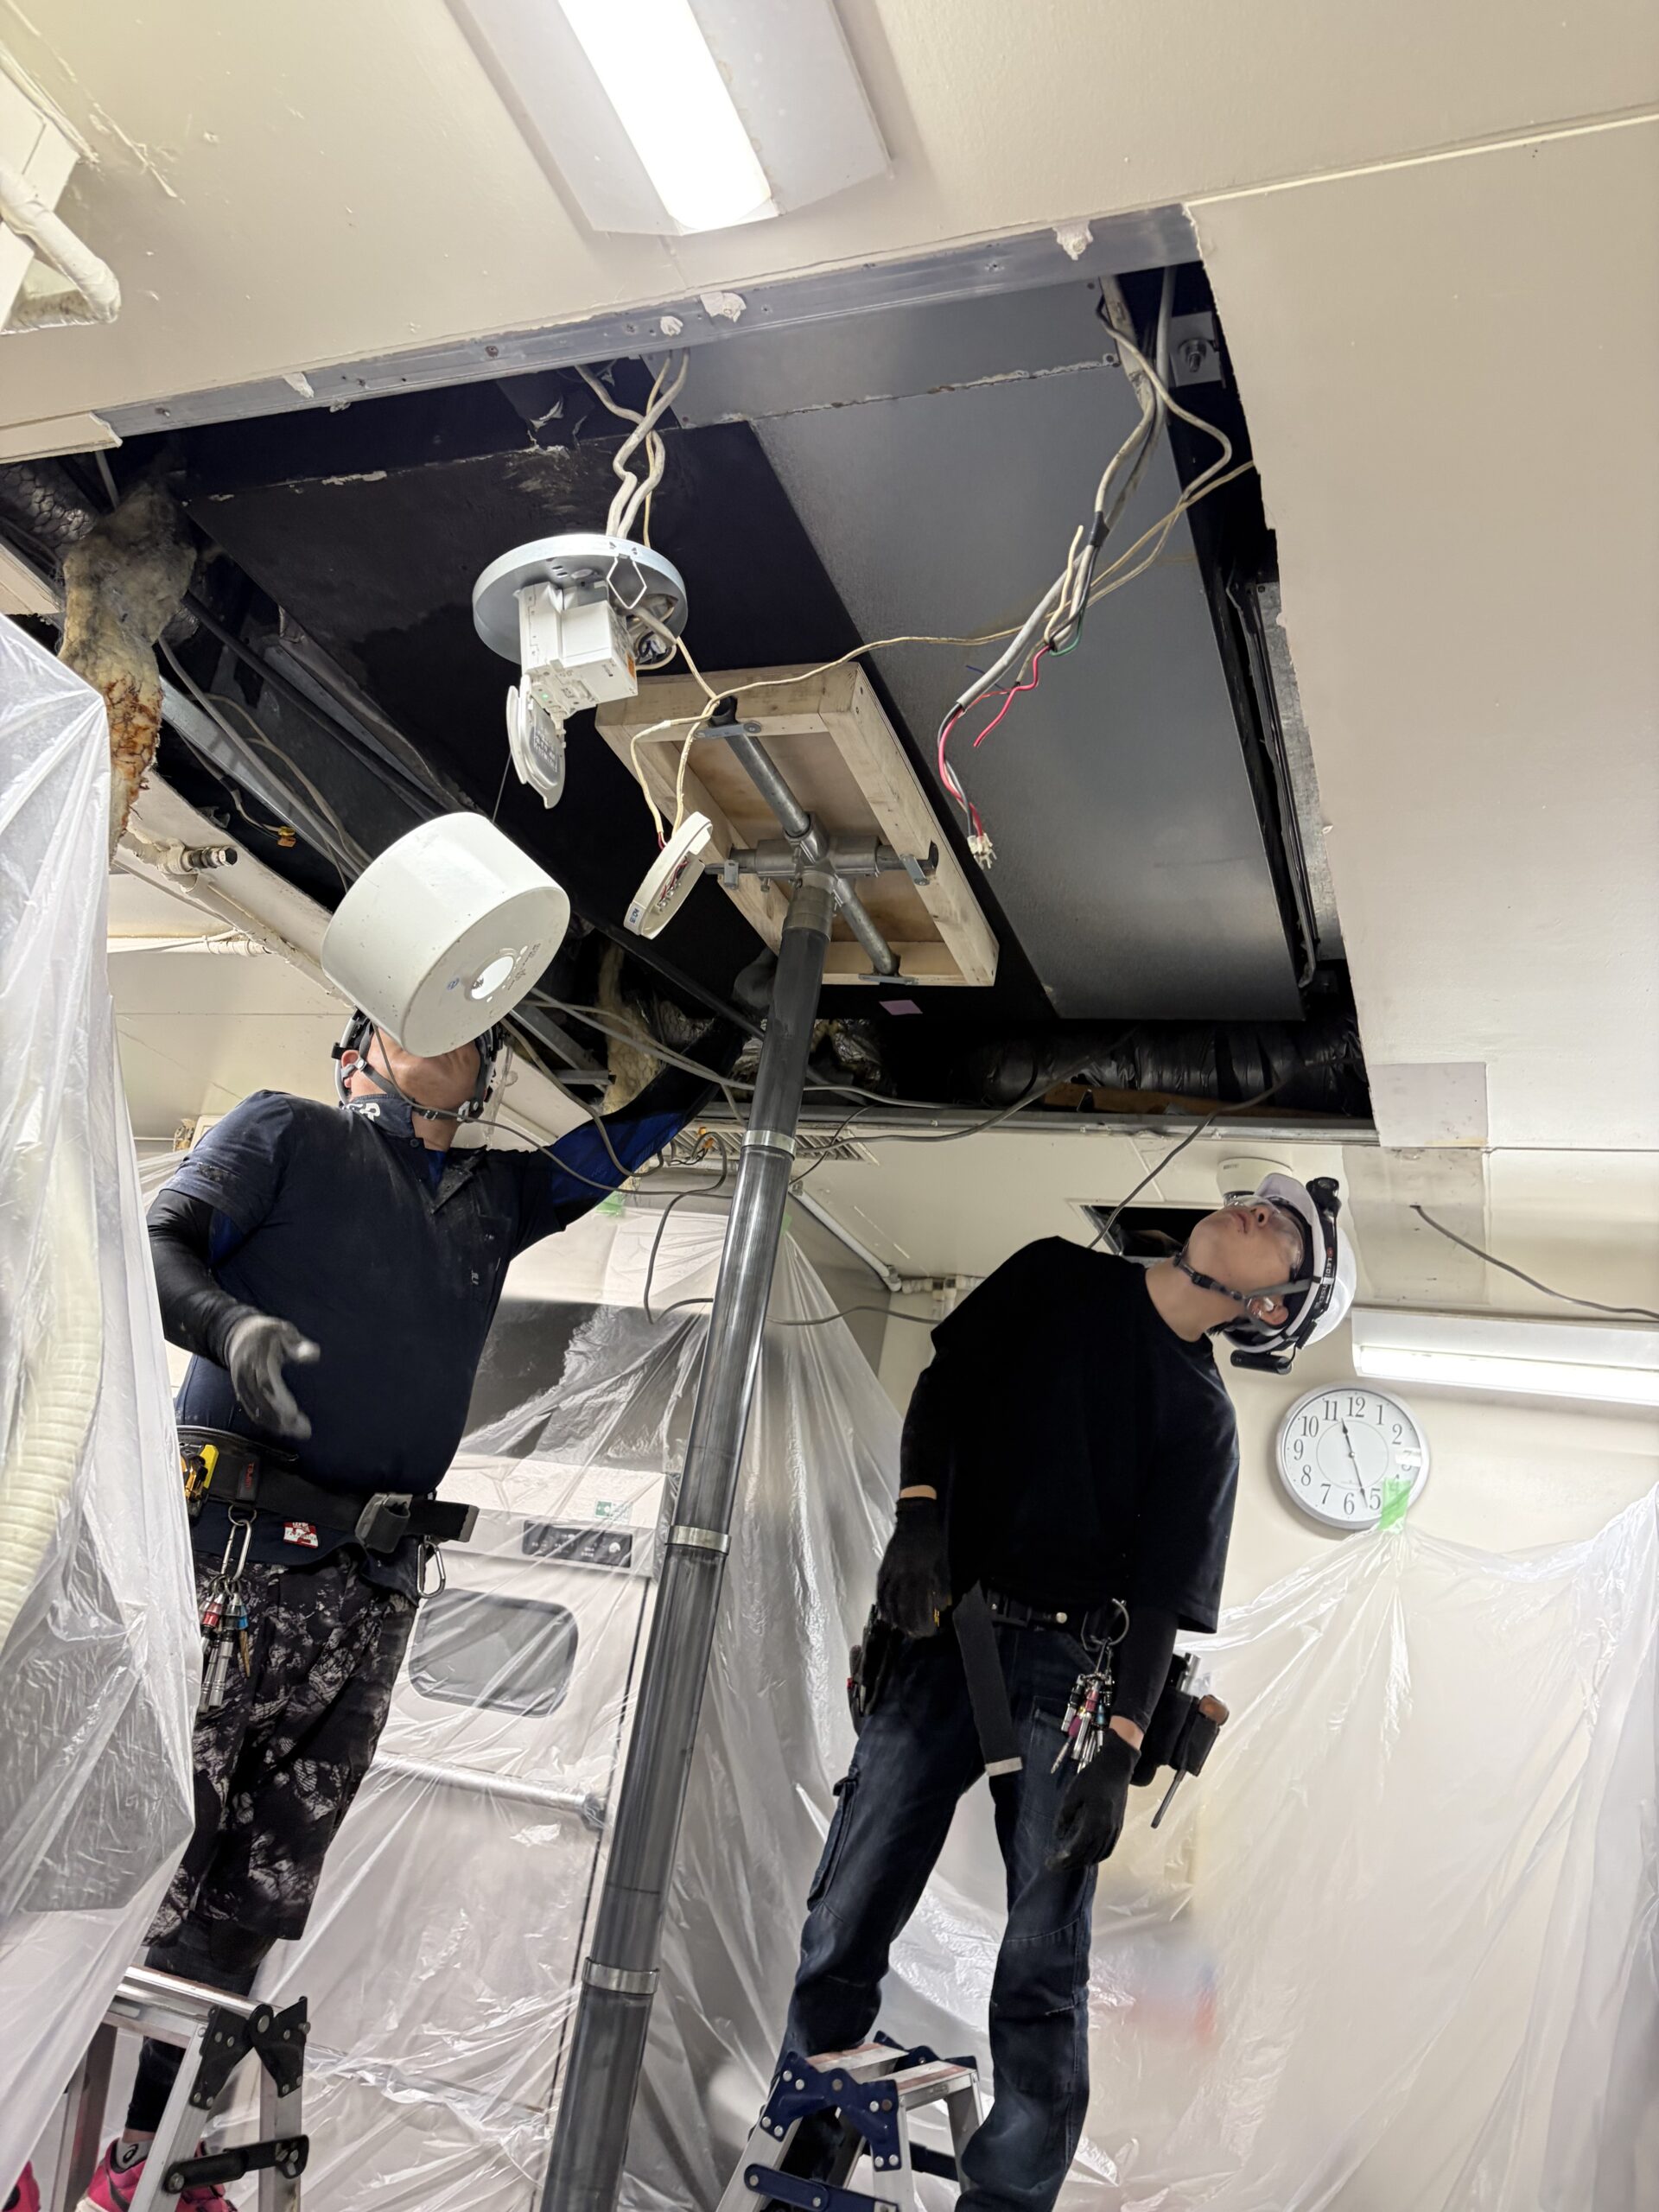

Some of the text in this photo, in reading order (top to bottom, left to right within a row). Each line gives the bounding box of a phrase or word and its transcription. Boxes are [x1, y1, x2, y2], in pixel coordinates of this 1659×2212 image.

[1323, 1400, 1338, 1421] 11
[1347, 1396, 1366, 1418] 12
[1376, 1404, 1384, 1426] 1
[1301, 1415, 1319, 1438] 10
[1392, 1424, 1403, 1445] 2
[1294, 1439, 1304, 1460] 9
[1300, 1465, 1312, 1486] 8
[1320, 1484, 1332, 1505] 7
[1344, 1492, 1355, 1516] 6
[1370, 1488, 1382, 1510] 5
